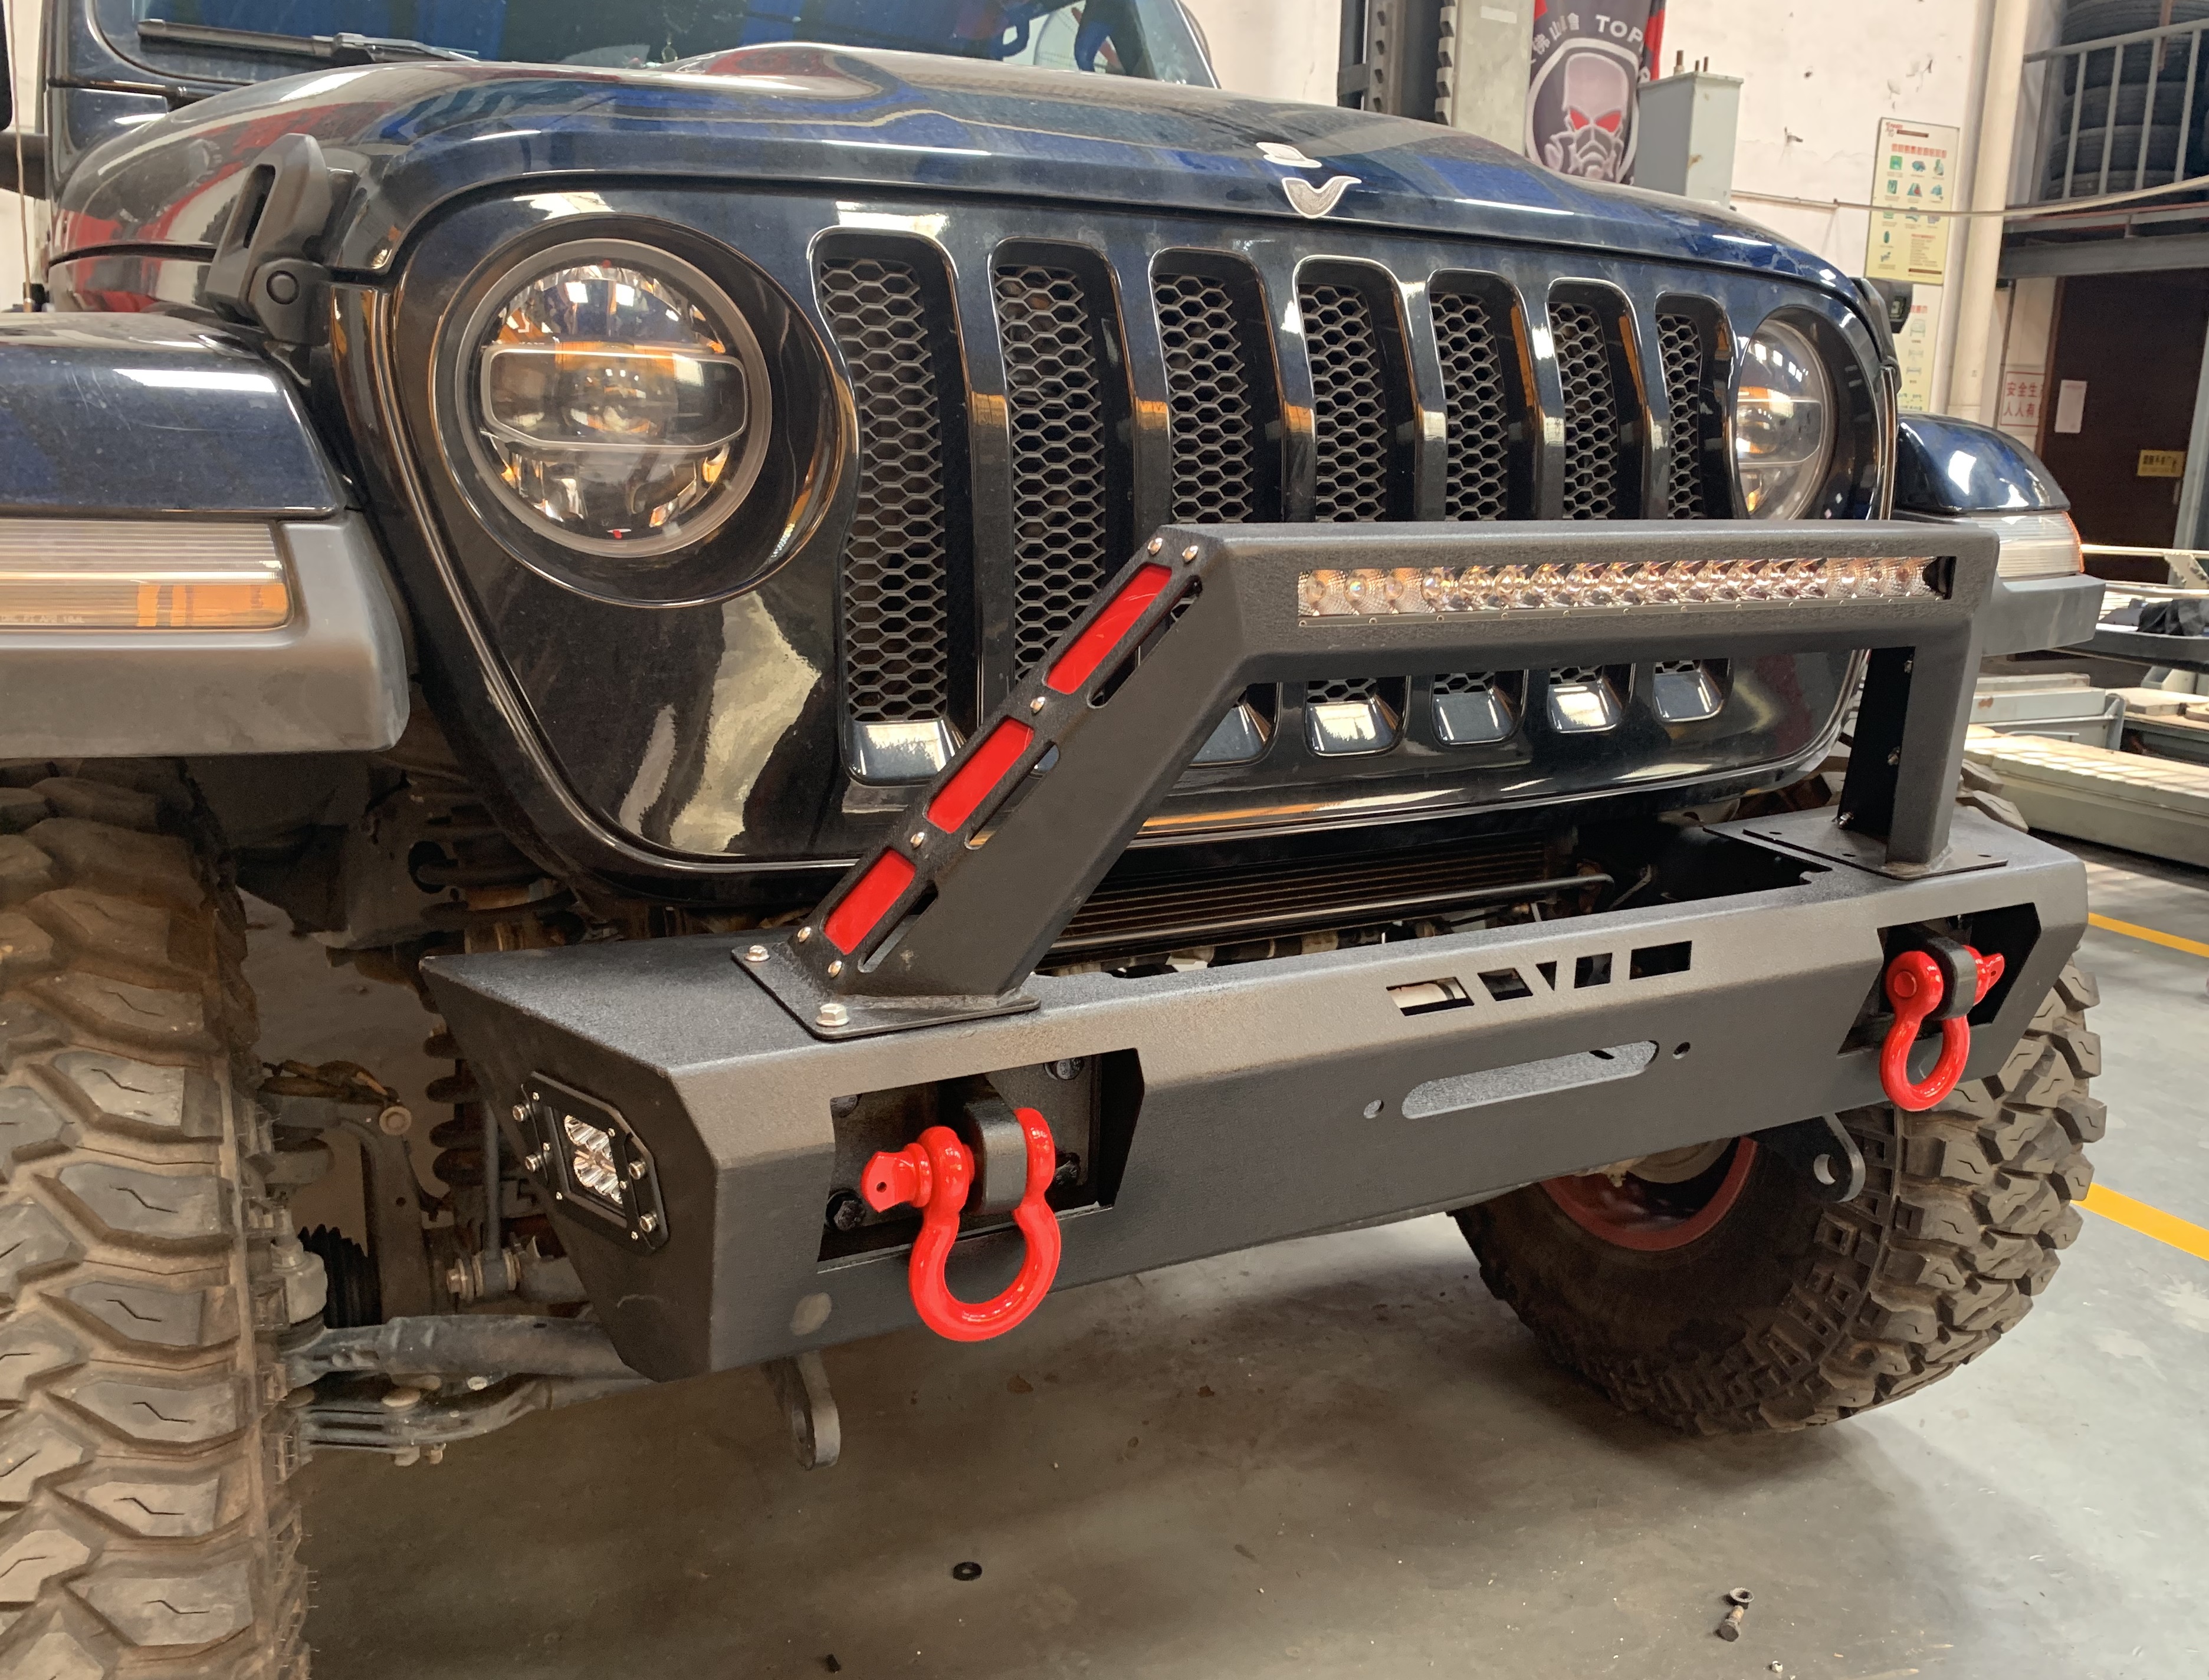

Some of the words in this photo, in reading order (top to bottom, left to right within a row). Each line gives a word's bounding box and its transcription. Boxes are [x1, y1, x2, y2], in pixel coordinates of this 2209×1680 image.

[1595, 14, 1644, 53] TOP
[2006, 382, 2043, 397] 安全生
[2003, 402, 2039, 418] 人人有
